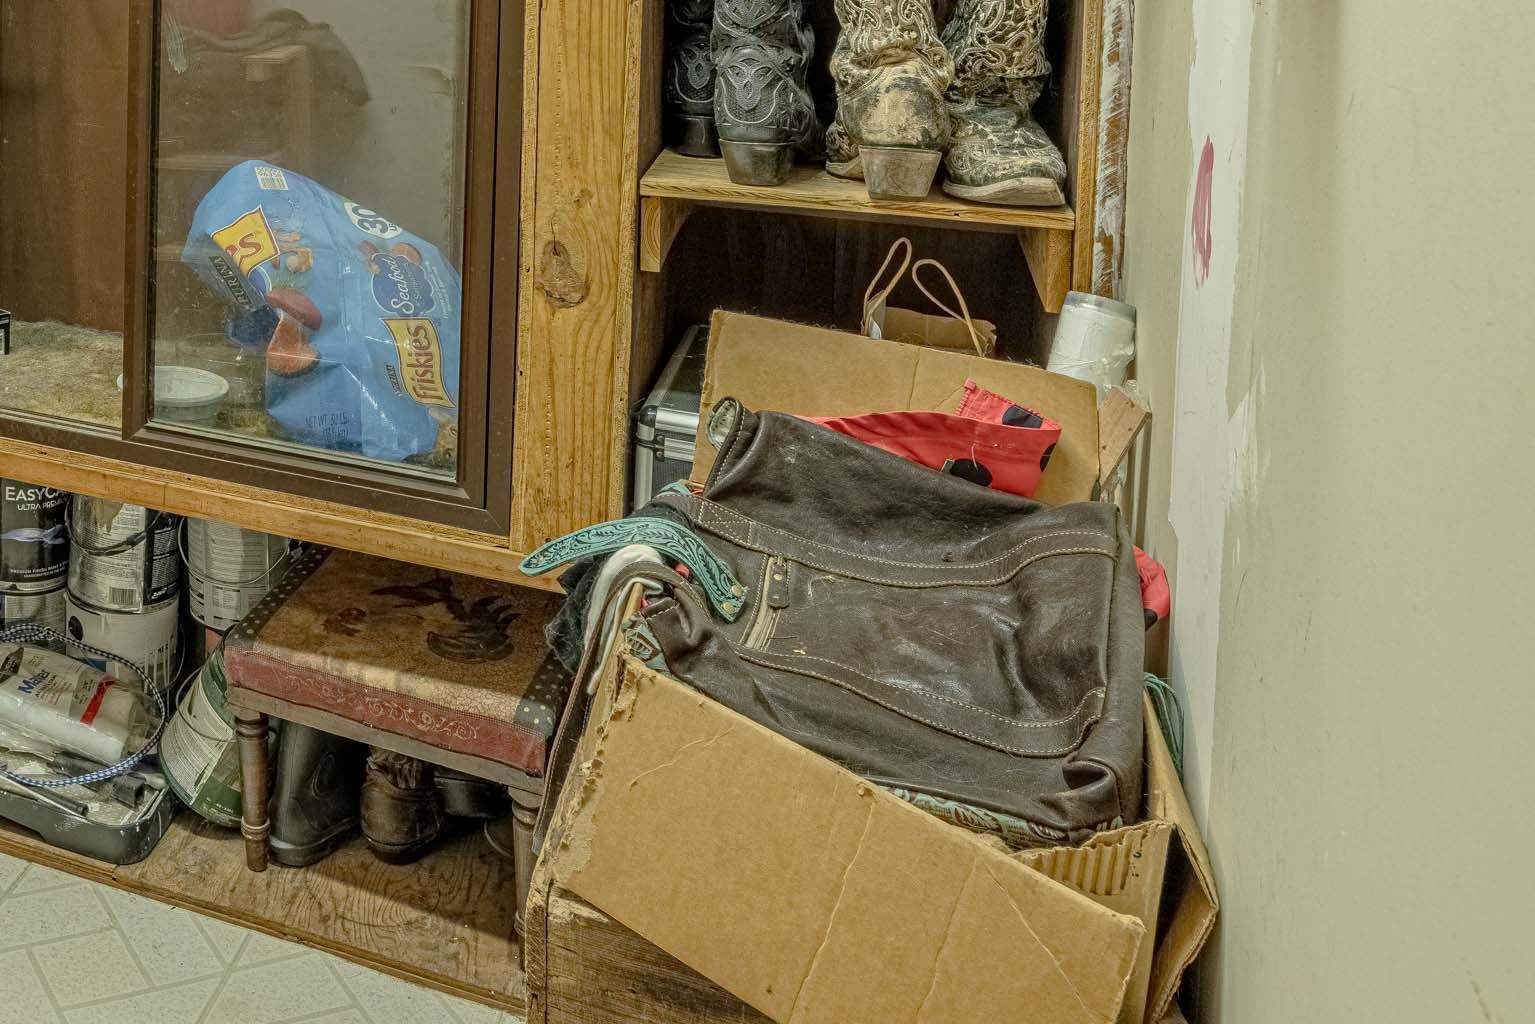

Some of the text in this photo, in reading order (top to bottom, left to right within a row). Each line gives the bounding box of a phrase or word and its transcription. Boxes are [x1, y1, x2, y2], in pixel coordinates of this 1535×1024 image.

[381, 256, 415, 314] Seafood
[5, 486, 65, 501] EASYCA
[17, 503, 41, 511] ULTRA
